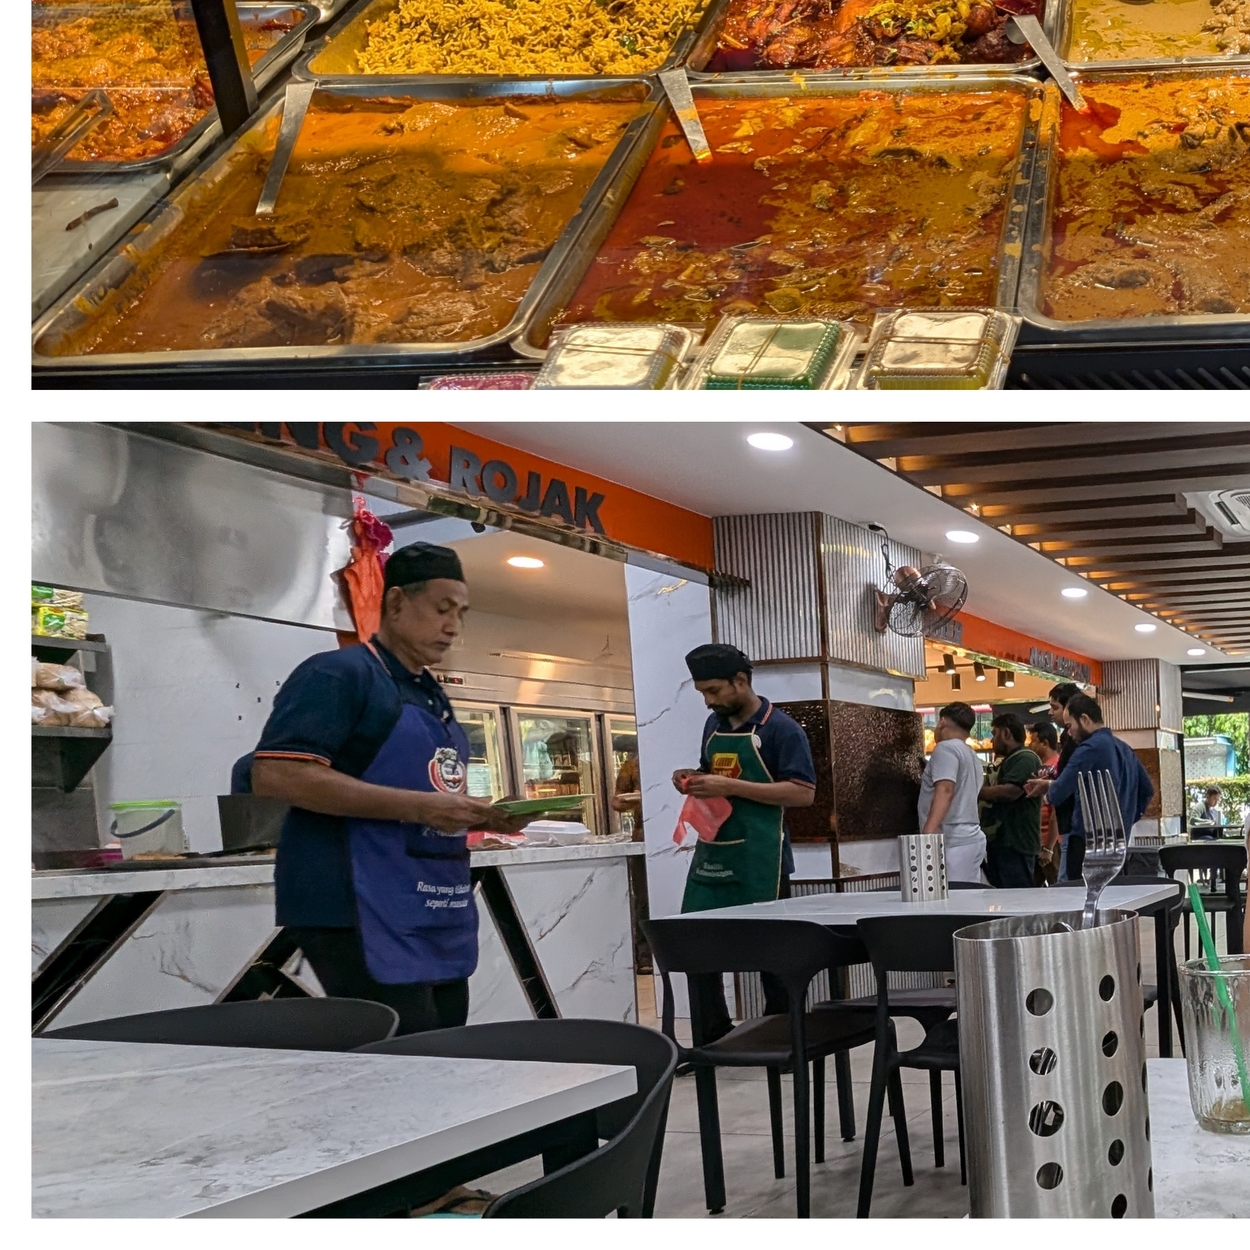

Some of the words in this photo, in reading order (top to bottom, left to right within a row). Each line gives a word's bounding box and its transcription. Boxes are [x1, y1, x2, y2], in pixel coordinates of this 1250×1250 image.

[384, 428, 432, 481] &
[450, 445, 607, 534] ROJAK
[416, 881, 436, 893] Rasa
[436, 885, 454, 896] yang
